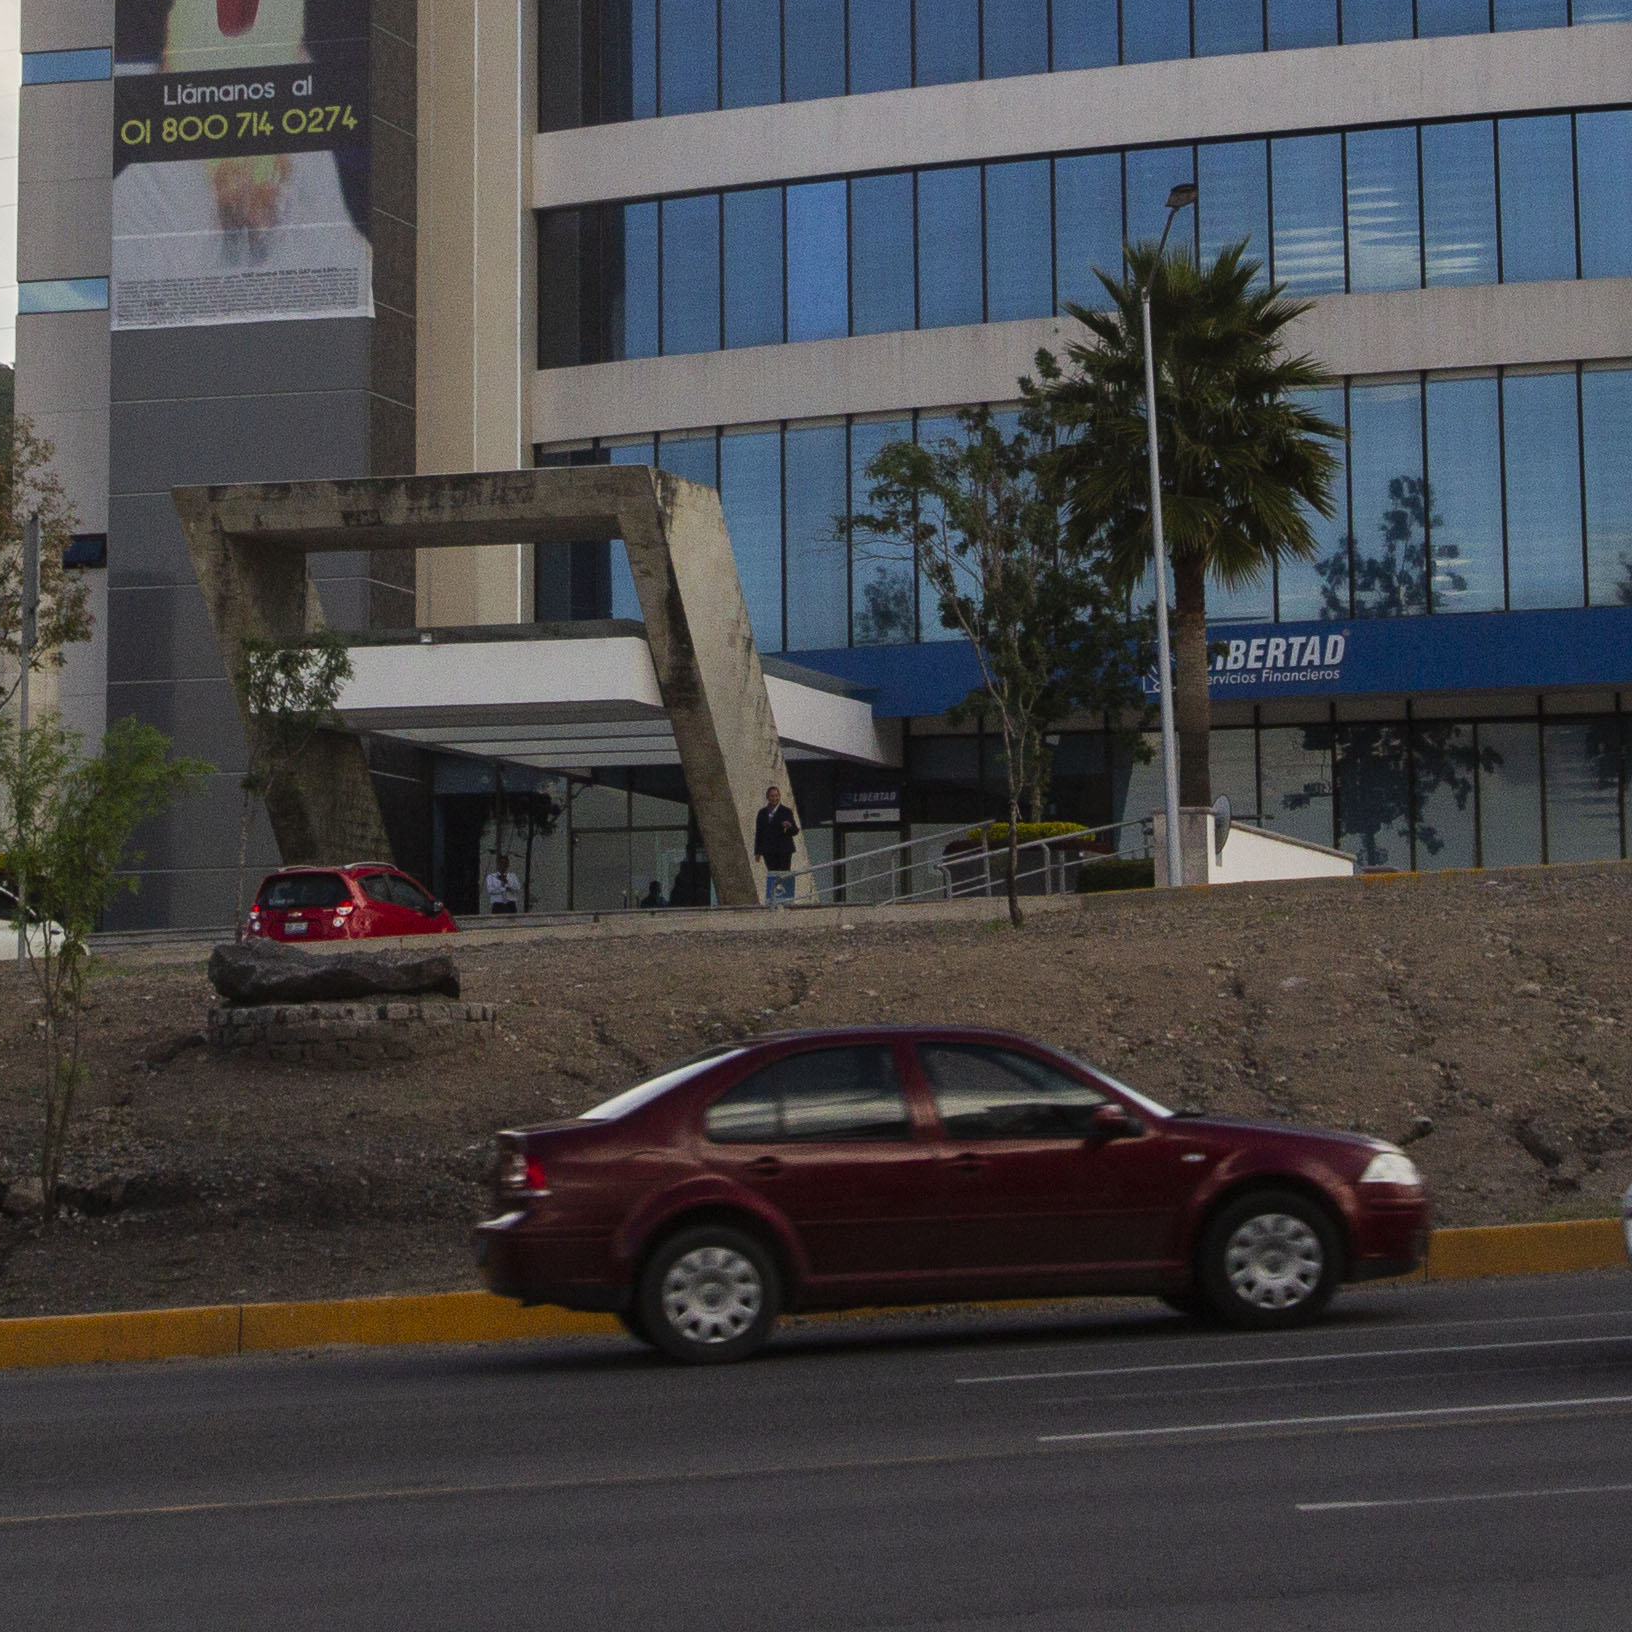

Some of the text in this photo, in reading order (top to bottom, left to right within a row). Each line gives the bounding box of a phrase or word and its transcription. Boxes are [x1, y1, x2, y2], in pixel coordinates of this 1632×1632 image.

[164, 75, 313, 106] Llámanos al
[121, 105, 358, 145] 01 800 714 0274
[1205, 668, 1341, 686] ervicios Financieros
